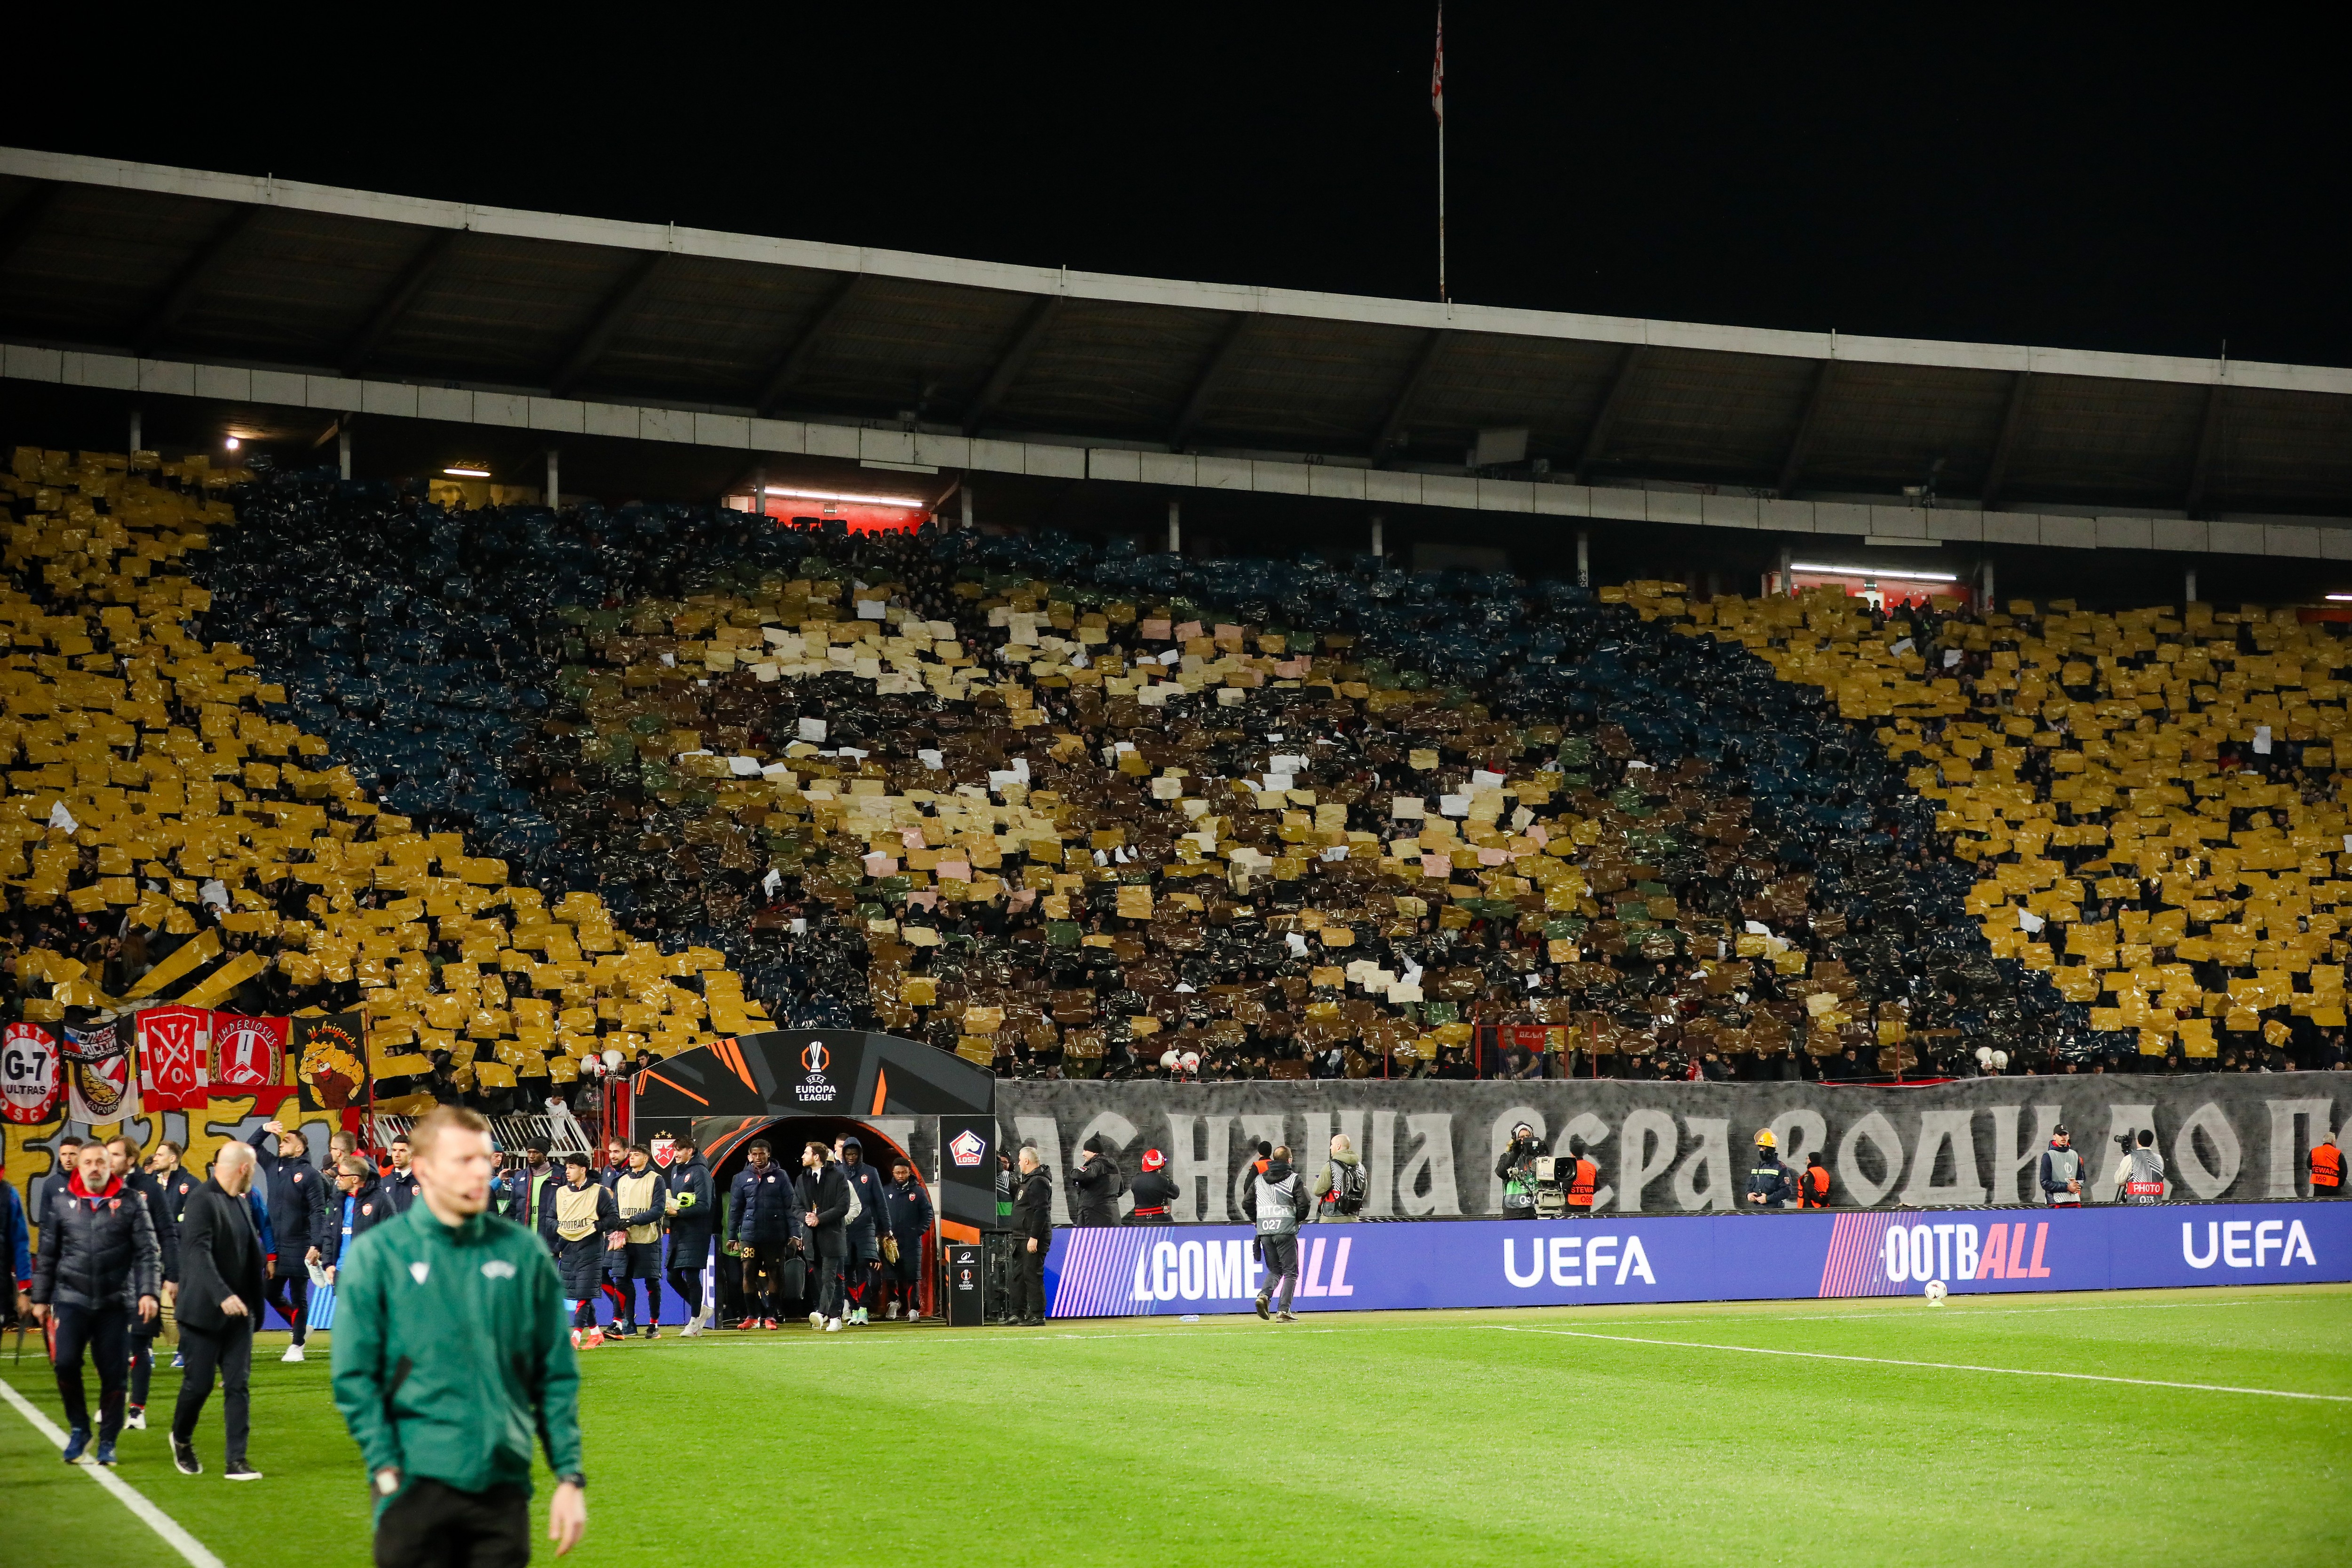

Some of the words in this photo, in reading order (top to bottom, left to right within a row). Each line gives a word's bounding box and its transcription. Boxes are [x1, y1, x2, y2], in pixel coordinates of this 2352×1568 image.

[217, 1019, 278, 1045] IMPERIOSUS
[307, 1020, 357, 1051] U-brigade
[97, 1046, 118, 1058] СКВА
[6, 1050, 46, 1081] G-7
[7, 1084, 46, 1095] ULTRAS
[2266, 1098, 2352, 1199] П
[2133, 1184, 2160, 1193] PHOTO
[558, 1218, 588, 1230] #FOOTBALL
[1257, 1205, 1289, 1217] PITCH
[1262, 1219, 1281, 1231] 027
[743, 1247, 755, 1258] 38
[1875, 1222, 2051, 1282] OOTBALL
[2182, 1219, 2317, 1269] UEFA
[1129, 1240, 1263, 1301] LCOME
[1503, 1235, 1657, 1288] UEFA
